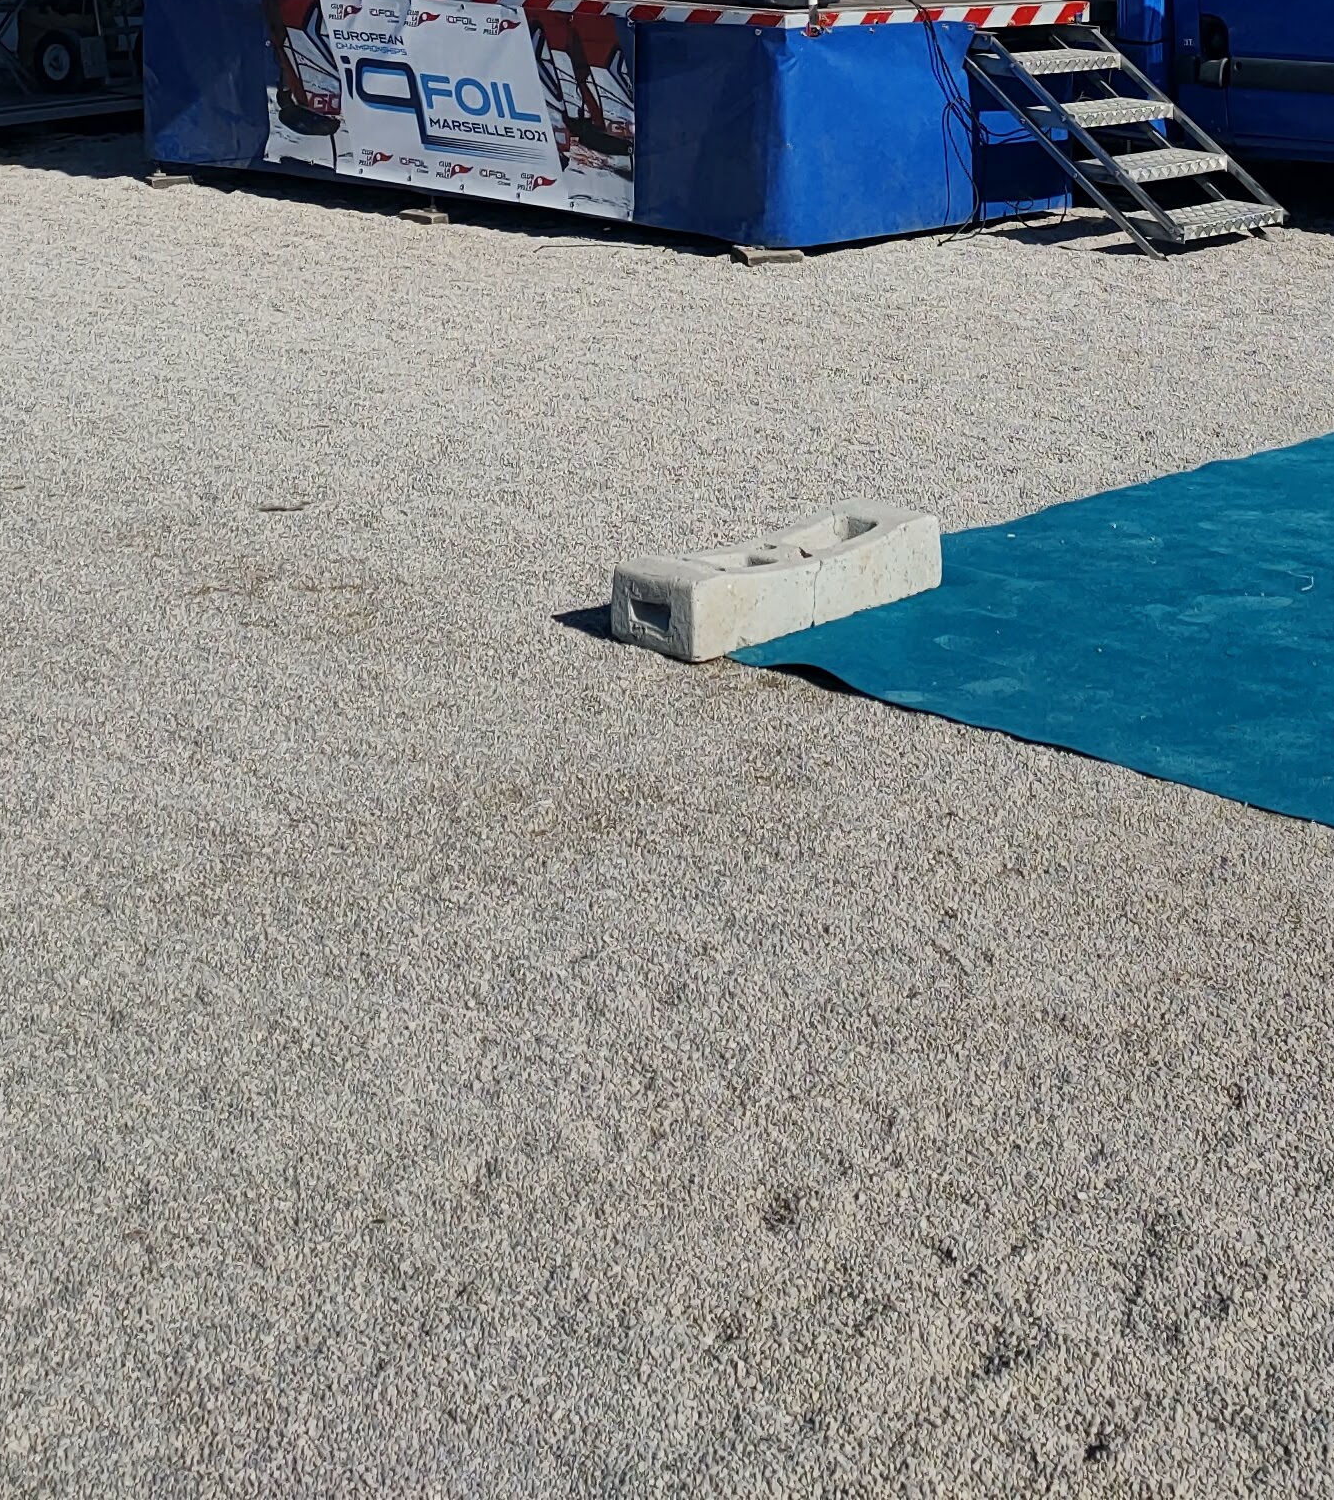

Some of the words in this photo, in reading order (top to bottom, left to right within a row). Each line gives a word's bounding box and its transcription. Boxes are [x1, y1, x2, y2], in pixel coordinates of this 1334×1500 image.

[333, 30, 404, 46] EUROPEAN
[335, 42, 407, 56] CHAMPIONSHIPS
[429, 116, 516, 139] MARSEILLE
[516, 128, 548, 143] 2021
